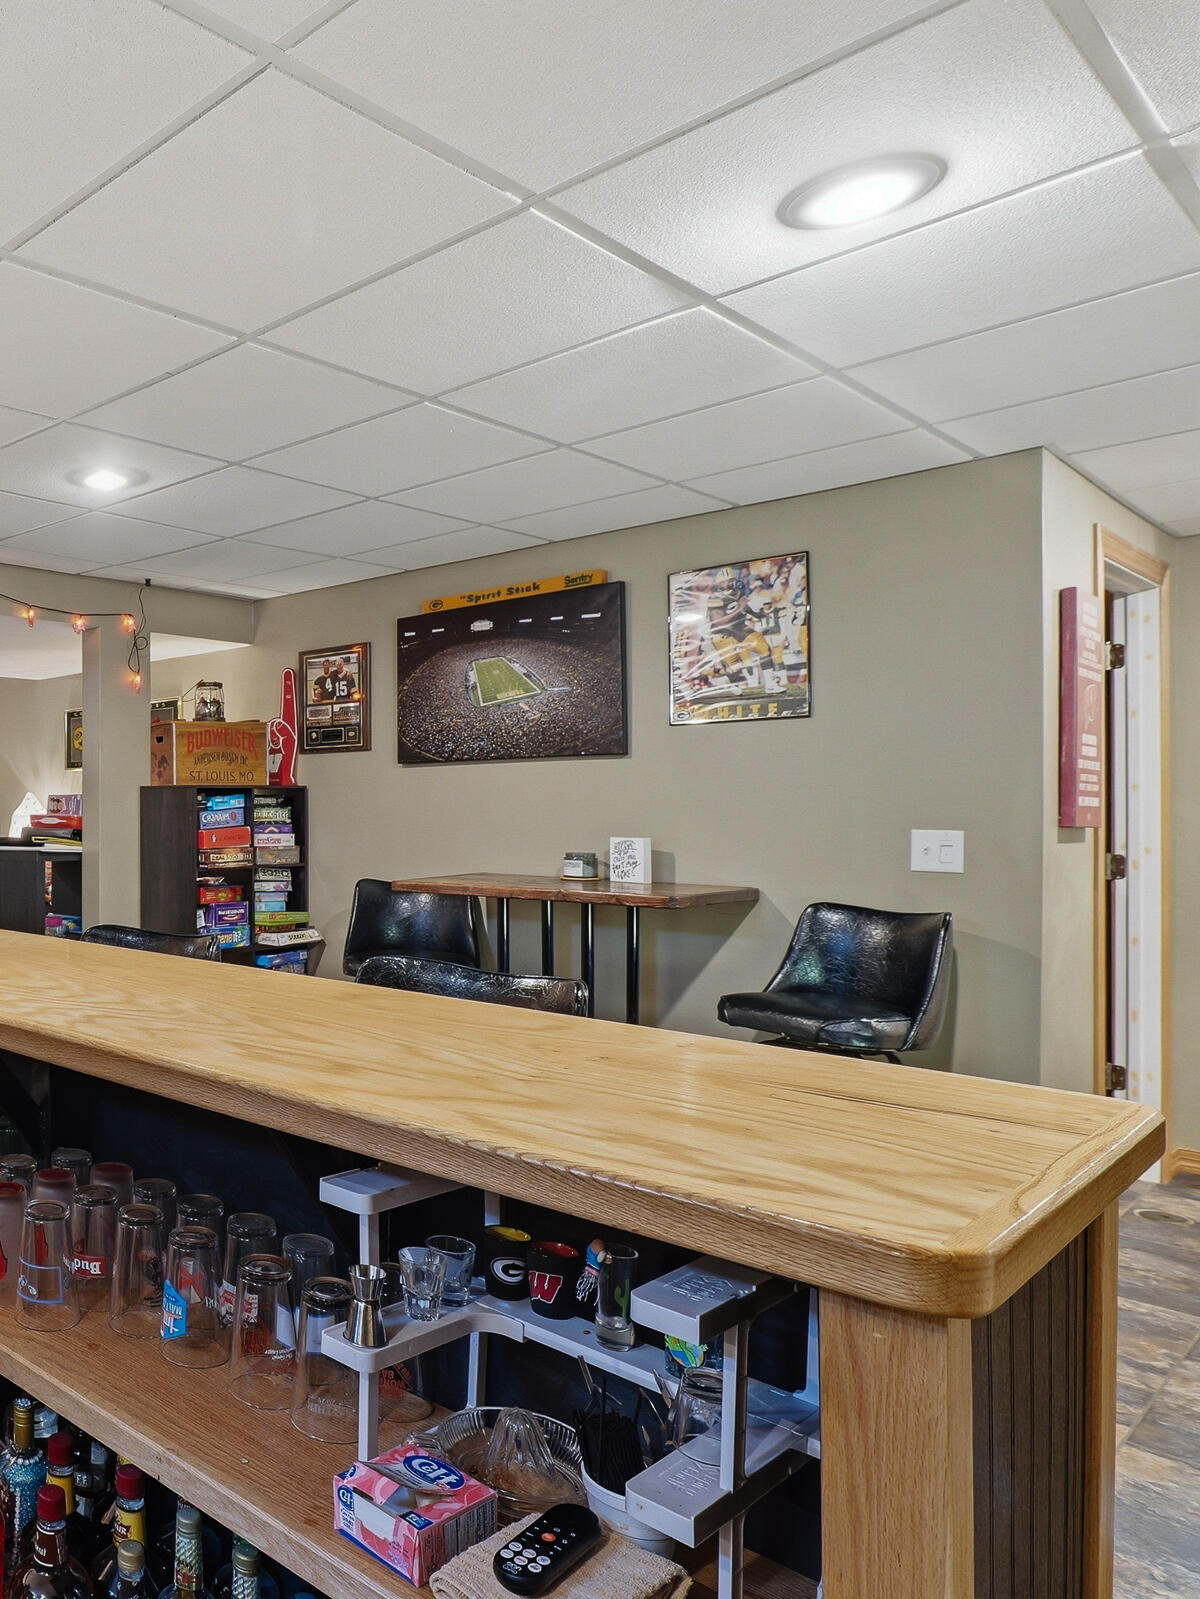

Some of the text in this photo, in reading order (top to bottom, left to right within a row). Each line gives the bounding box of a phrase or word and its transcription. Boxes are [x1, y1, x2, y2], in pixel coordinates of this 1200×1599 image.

[325, 677, 348, 697] 4 15
[186, 727, 259, 761] BUDWEISER
[528, 1269, 565, 1305] W
